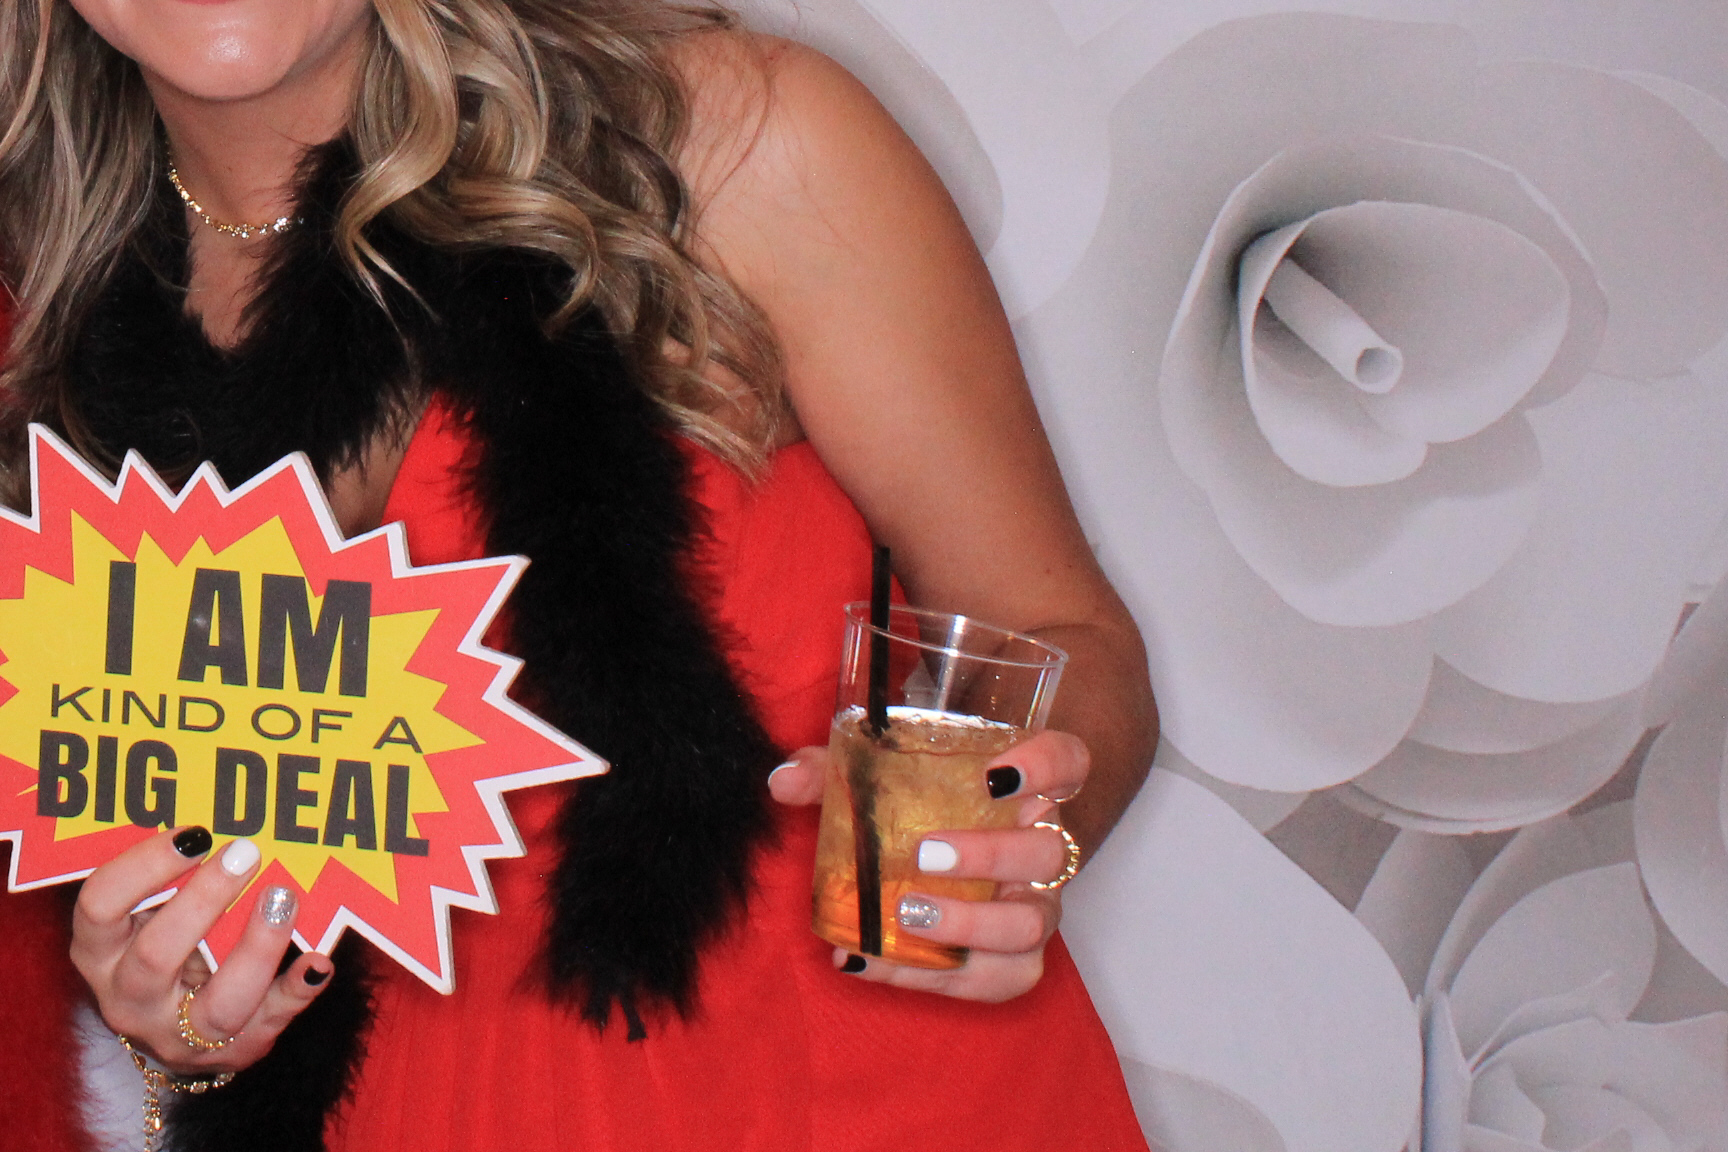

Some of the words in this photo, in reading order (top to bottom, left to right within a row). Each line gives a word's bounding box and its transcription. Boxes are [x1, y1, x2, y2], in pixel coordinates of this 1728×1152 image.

[105, 560, 137, 675] I
[177, 567, 371, 697] AM
[51, 683, 225, 732] KIND
[251, 703, 353, 744] OF
[373, 716, 423, 753] A
[36, 729, 178, 829] BIG
[213, 746, 429, 857] DEAL
